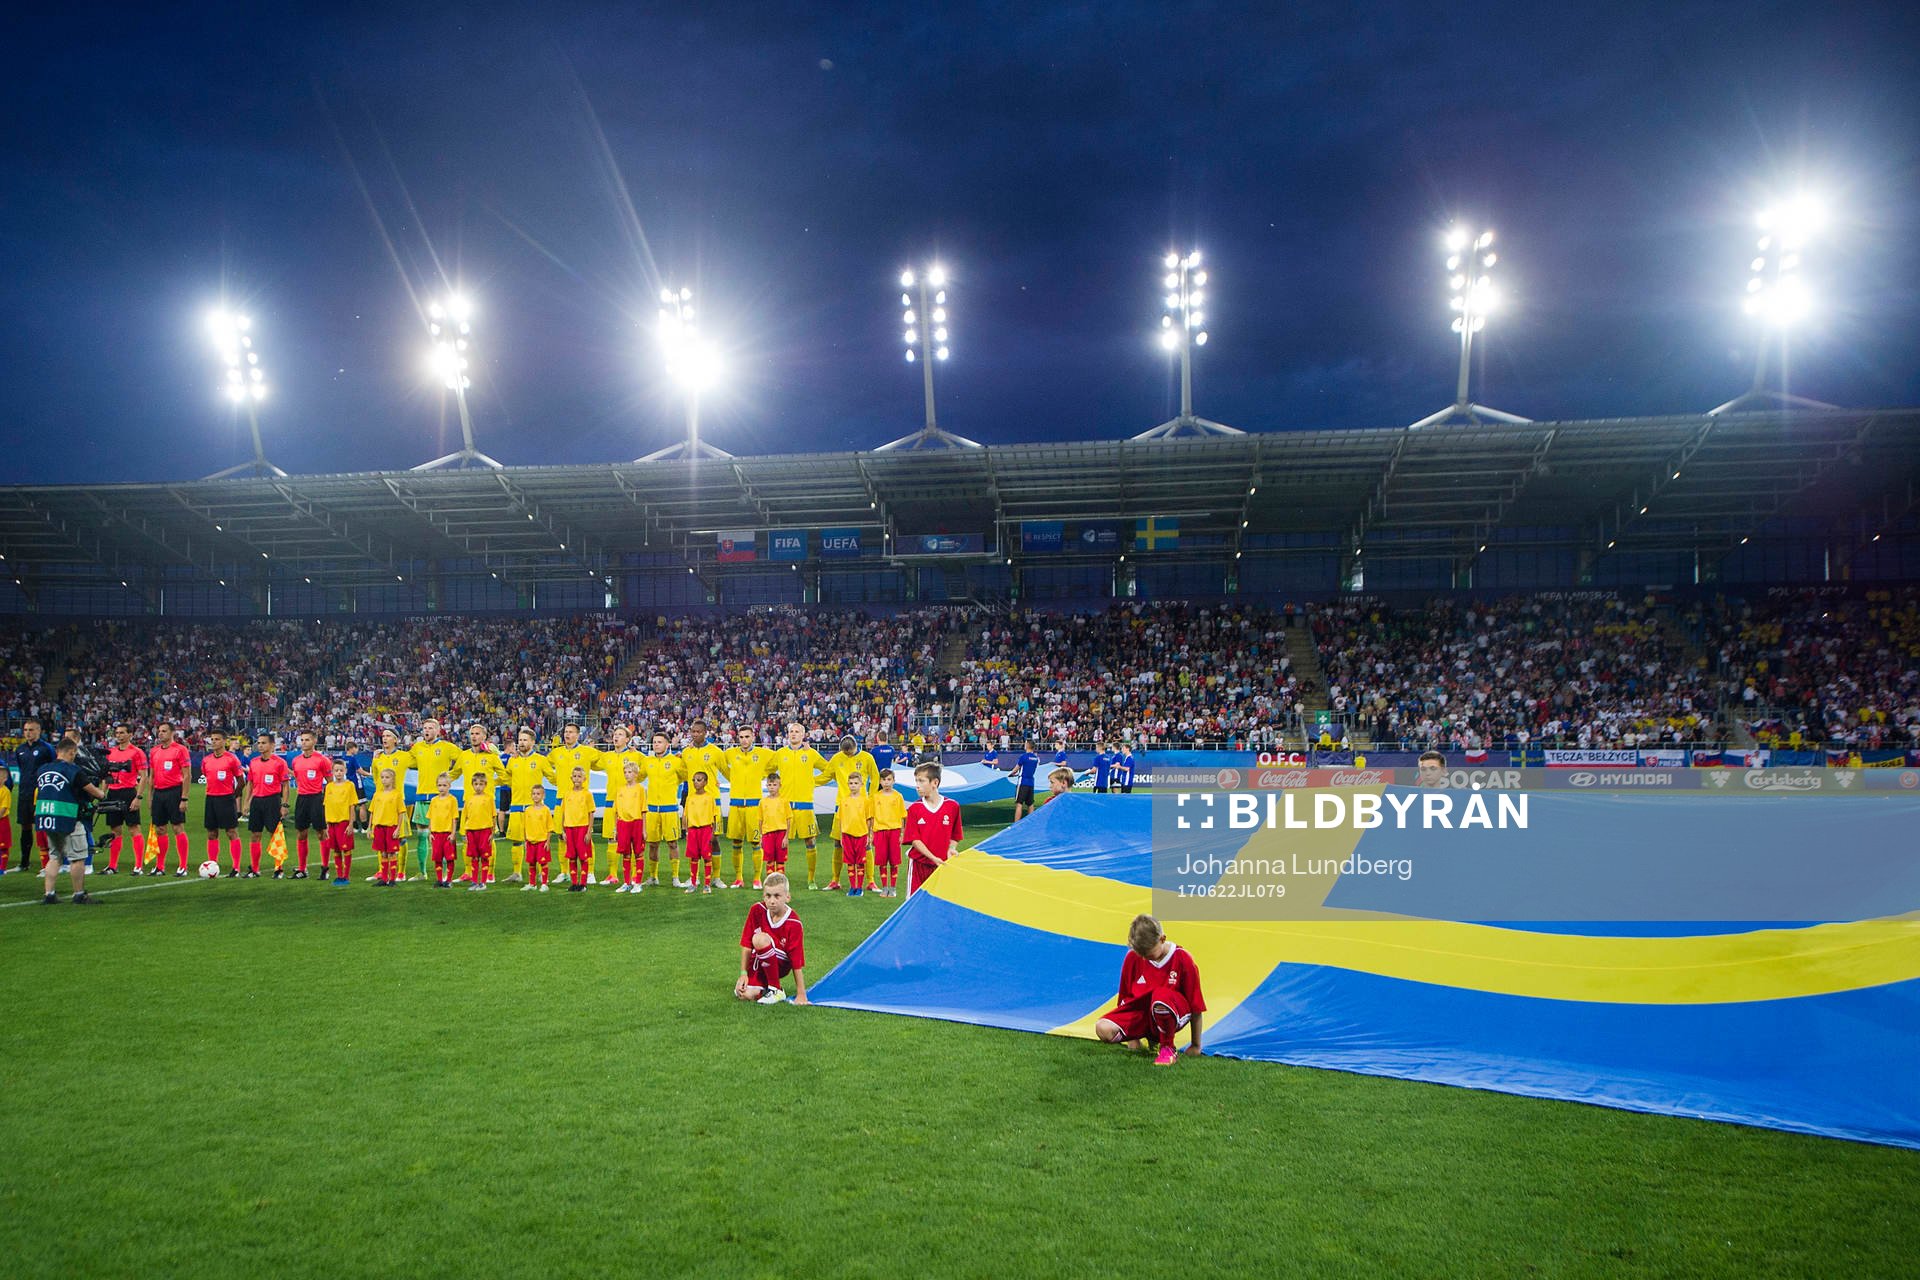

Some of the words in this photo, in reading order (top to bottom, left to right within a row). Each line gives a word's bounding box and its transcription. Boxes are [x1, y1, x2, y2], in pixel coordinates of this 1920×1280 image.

[775, 538, 800, 548] FIFA
[823, 538, 858, 549] UEFA
[38, 774, 66, 790] UEFA
[1133, 774, 1165, 785] RKISH
[1166, 774, 1217, 784] AIRLINES
[1600, 773, 1672, 785] HYUNDAI
[1744, 770, 1822, 790] Carlsberg
[38, 816, 56, 830] 101
